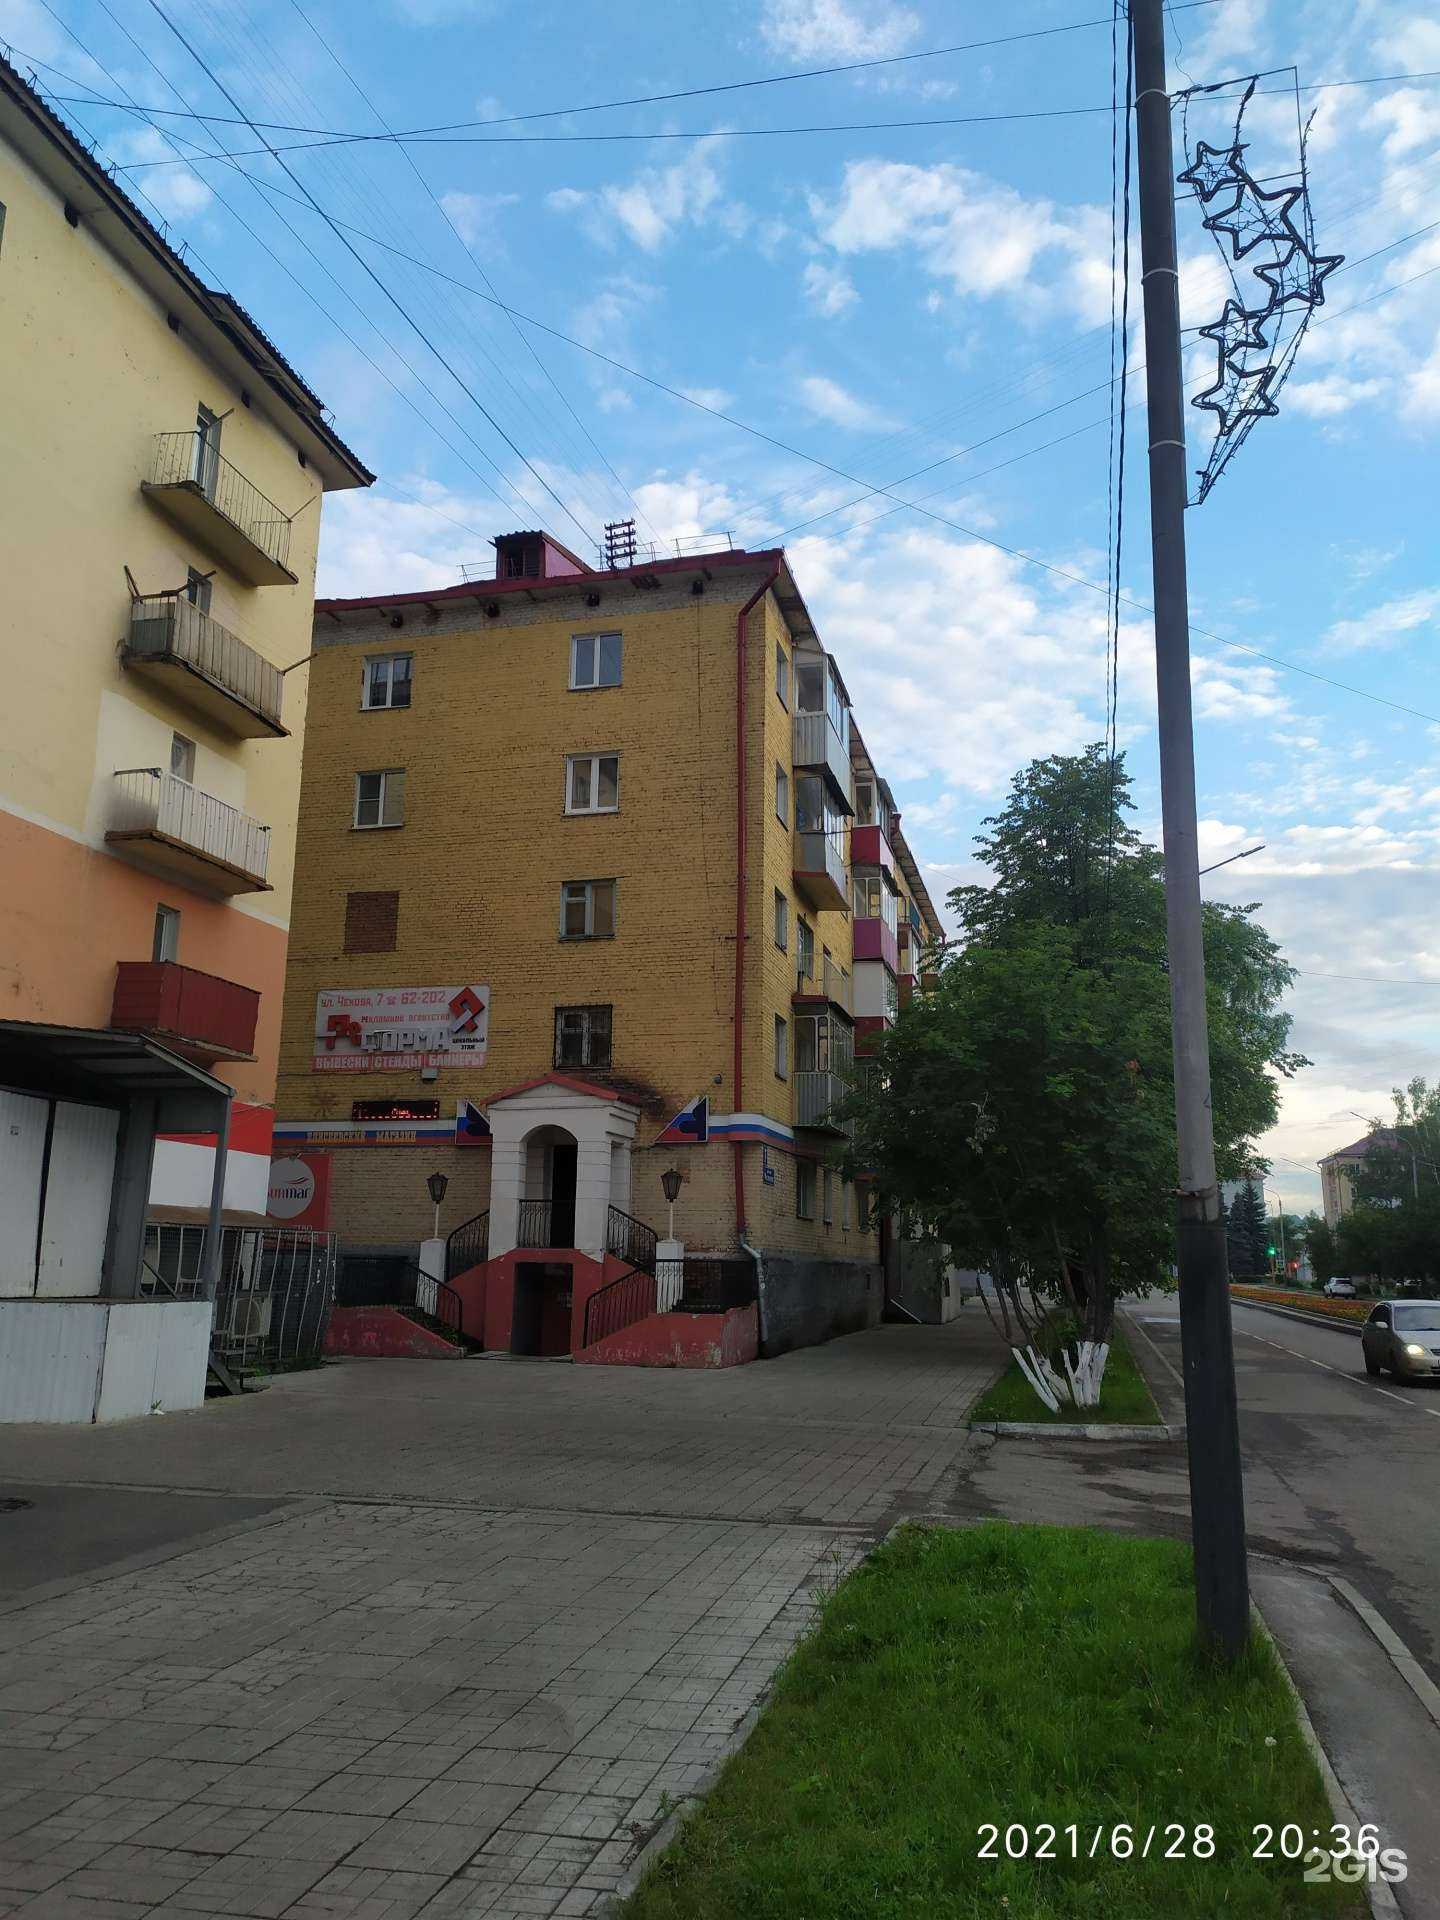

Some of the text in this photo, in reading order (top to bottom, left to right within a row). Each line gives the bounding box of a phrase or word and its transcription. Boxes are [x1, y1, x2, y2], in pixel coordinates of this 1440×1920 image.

[400, 990, 446, 1005] 62-202
[315, 1053, 484, 1069] ВЫВЕСКИ СТЕНДЫ БАННЕРЫ
